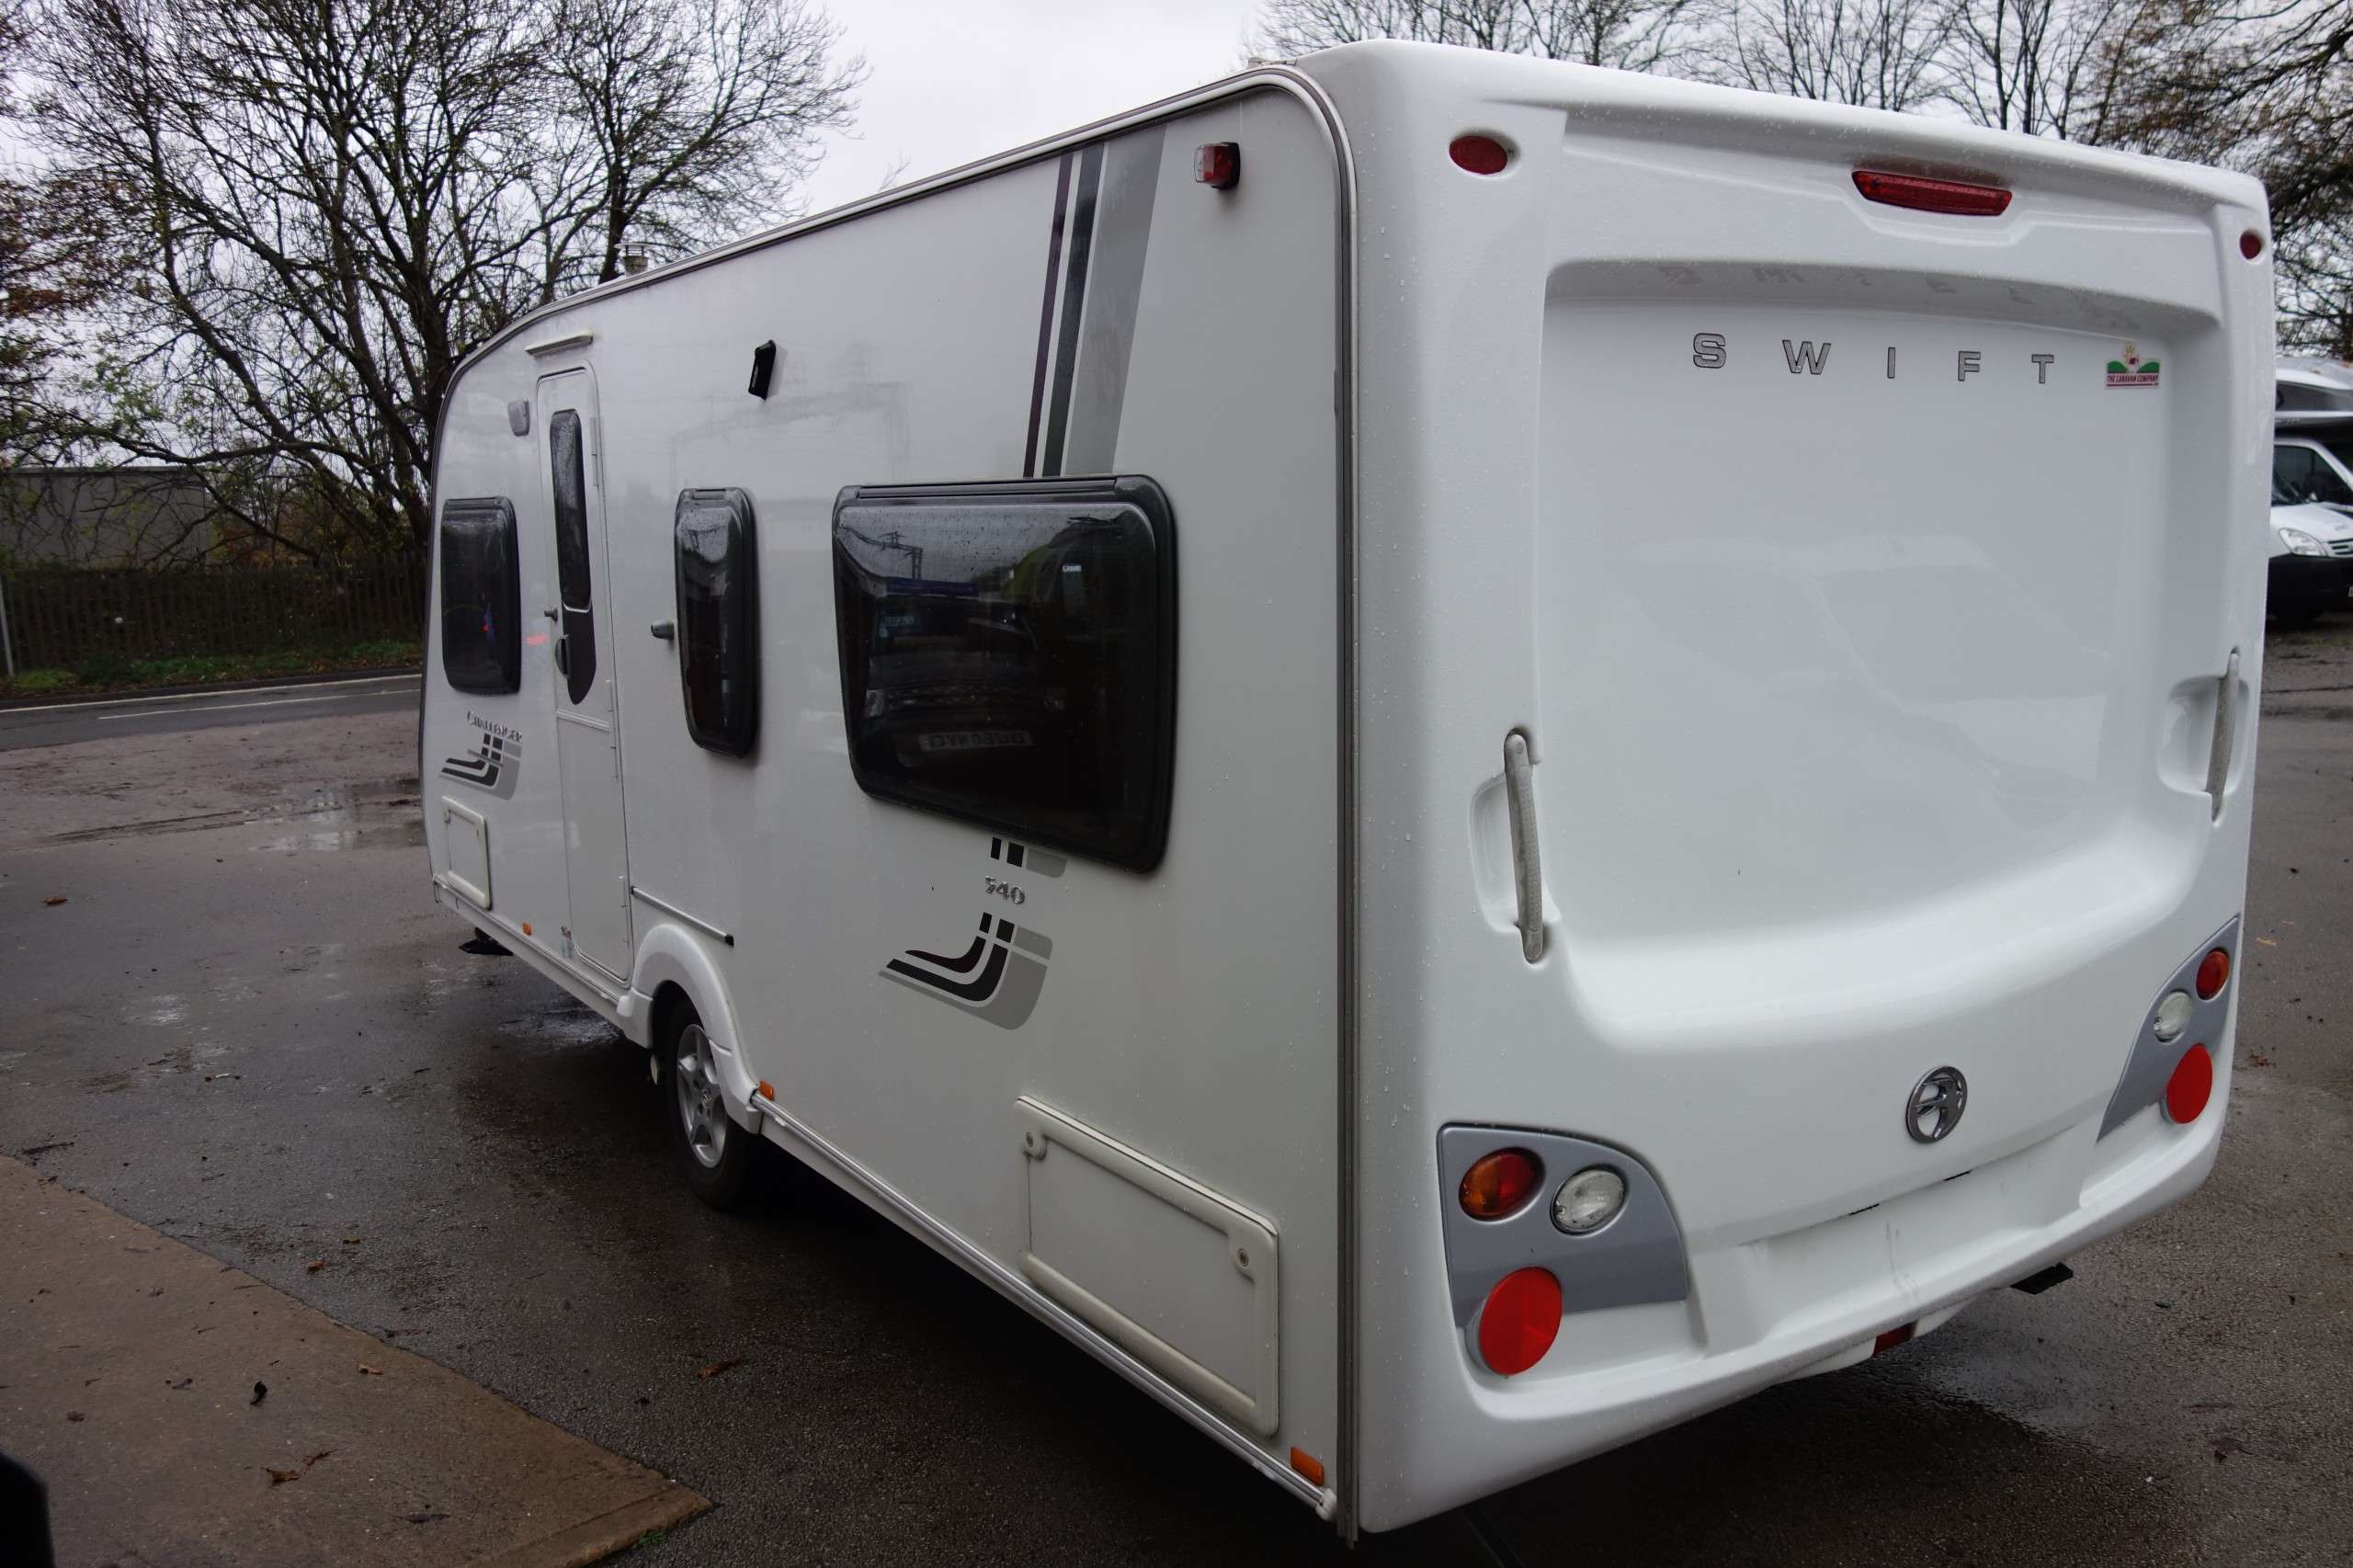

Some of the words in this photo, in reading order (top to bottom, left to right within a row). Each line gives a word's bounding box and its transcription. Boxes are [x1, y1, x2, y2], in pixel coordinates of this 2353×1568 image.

[1692, 332, 2055, 384] SWIFT
[2116, 374, 2136, 383] CARAVAN
[2137, 374, 2159, 383] COMPANY
[985, 875, 1025, 904] 540
